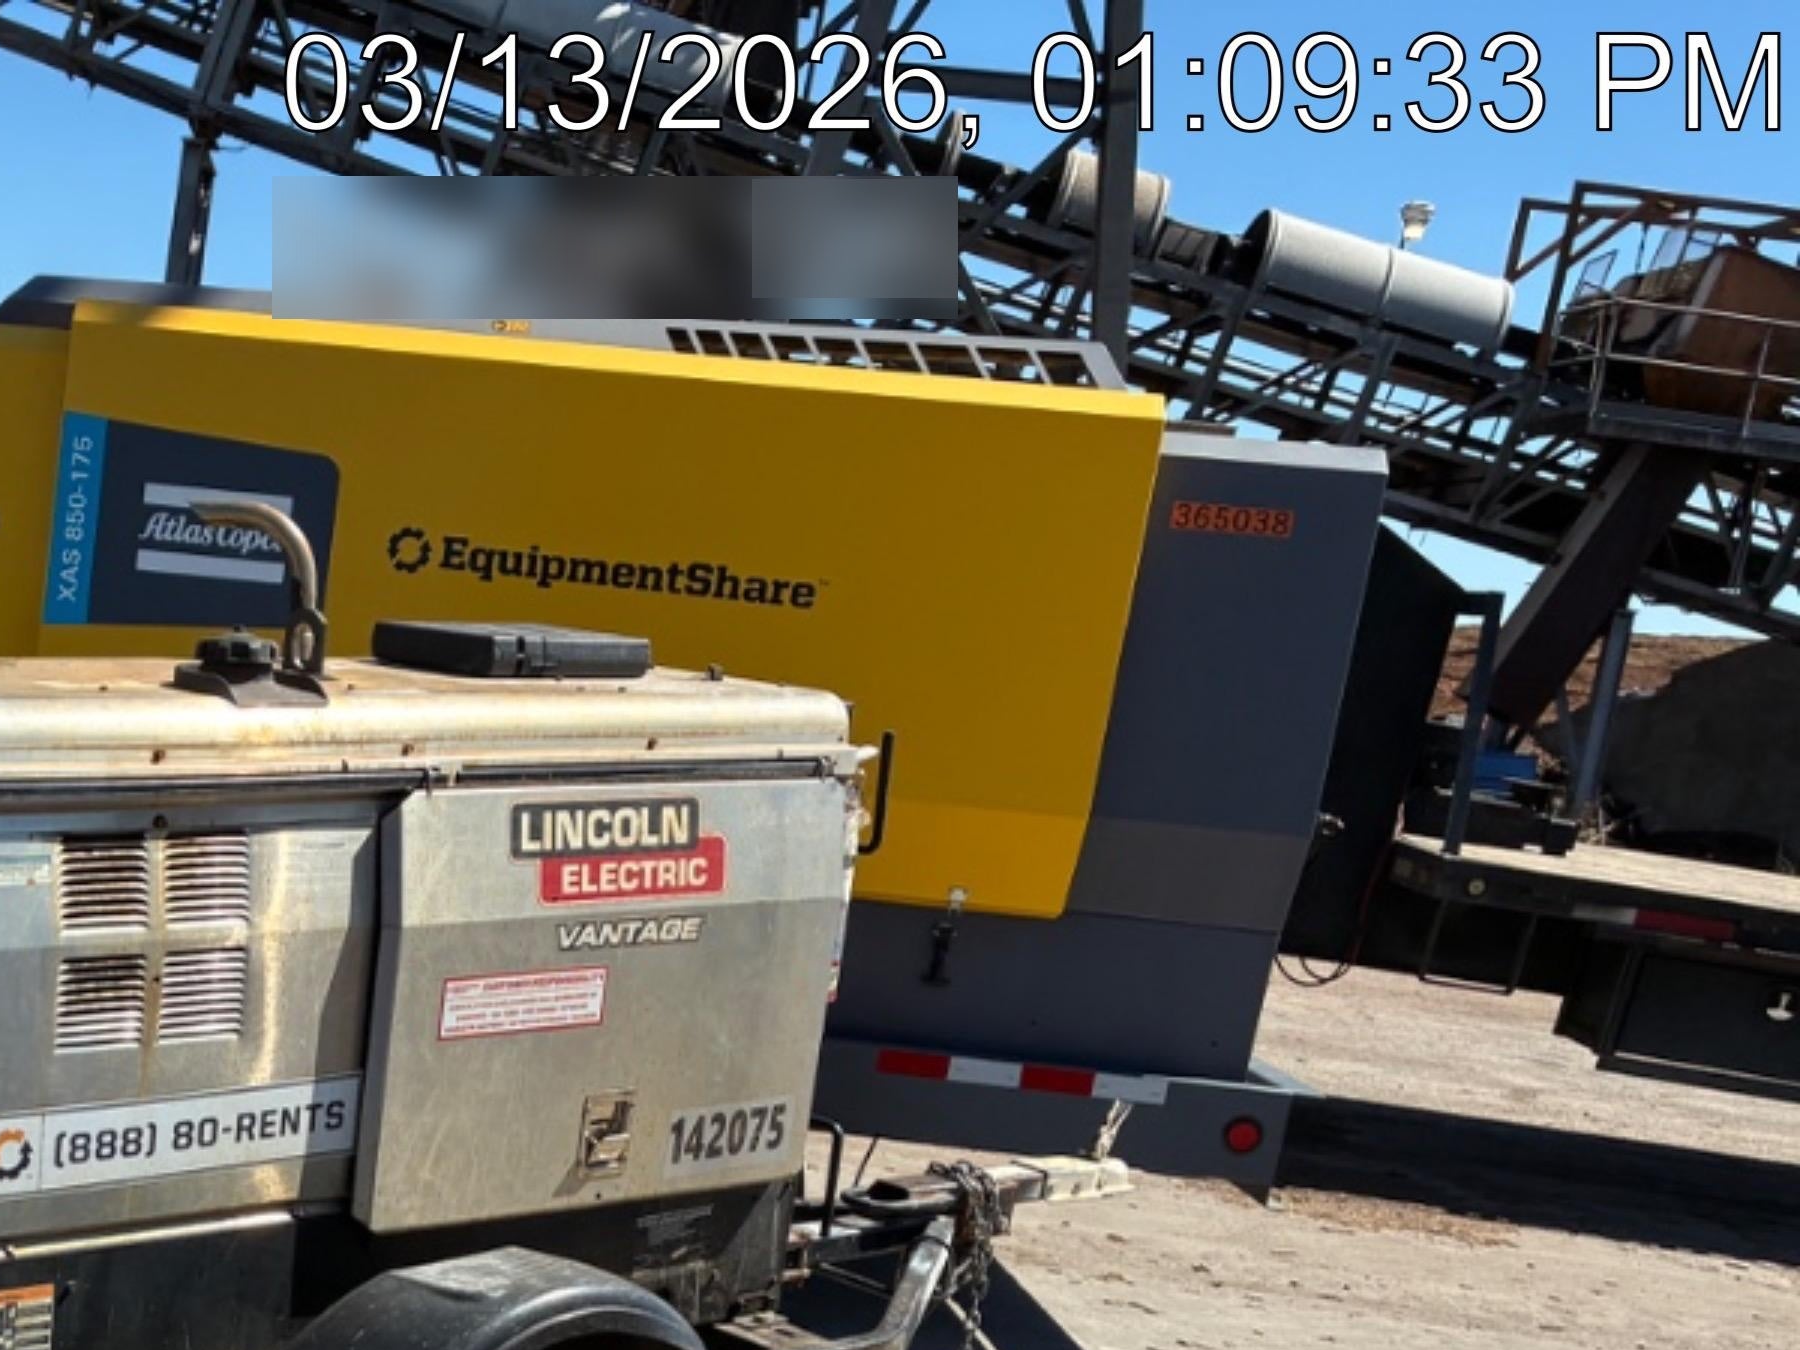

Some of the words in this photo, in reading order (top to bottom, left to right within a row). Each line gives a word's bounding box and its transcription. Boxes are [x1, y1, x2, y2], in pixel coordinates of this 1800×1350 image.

[65, 436, 93, 542] 850-175
[137, 511, 213, 543] Atlas
[1174, 503, 1290, 534] 365038
[57, 549, 82, 602] XAS
[439, 536, 817, 609] EquipmentShare
[520, 805, 690, 851] LINCOLN
[560, 856, 709, 895] ELECTRIC
[557, 915, 706, 950] VANTAGE
[53, 1122, 157, 1168] (888)
[172, 1100, 346, 1150] 80-RENTS
[670, 1103, 787, 1165] 142075
